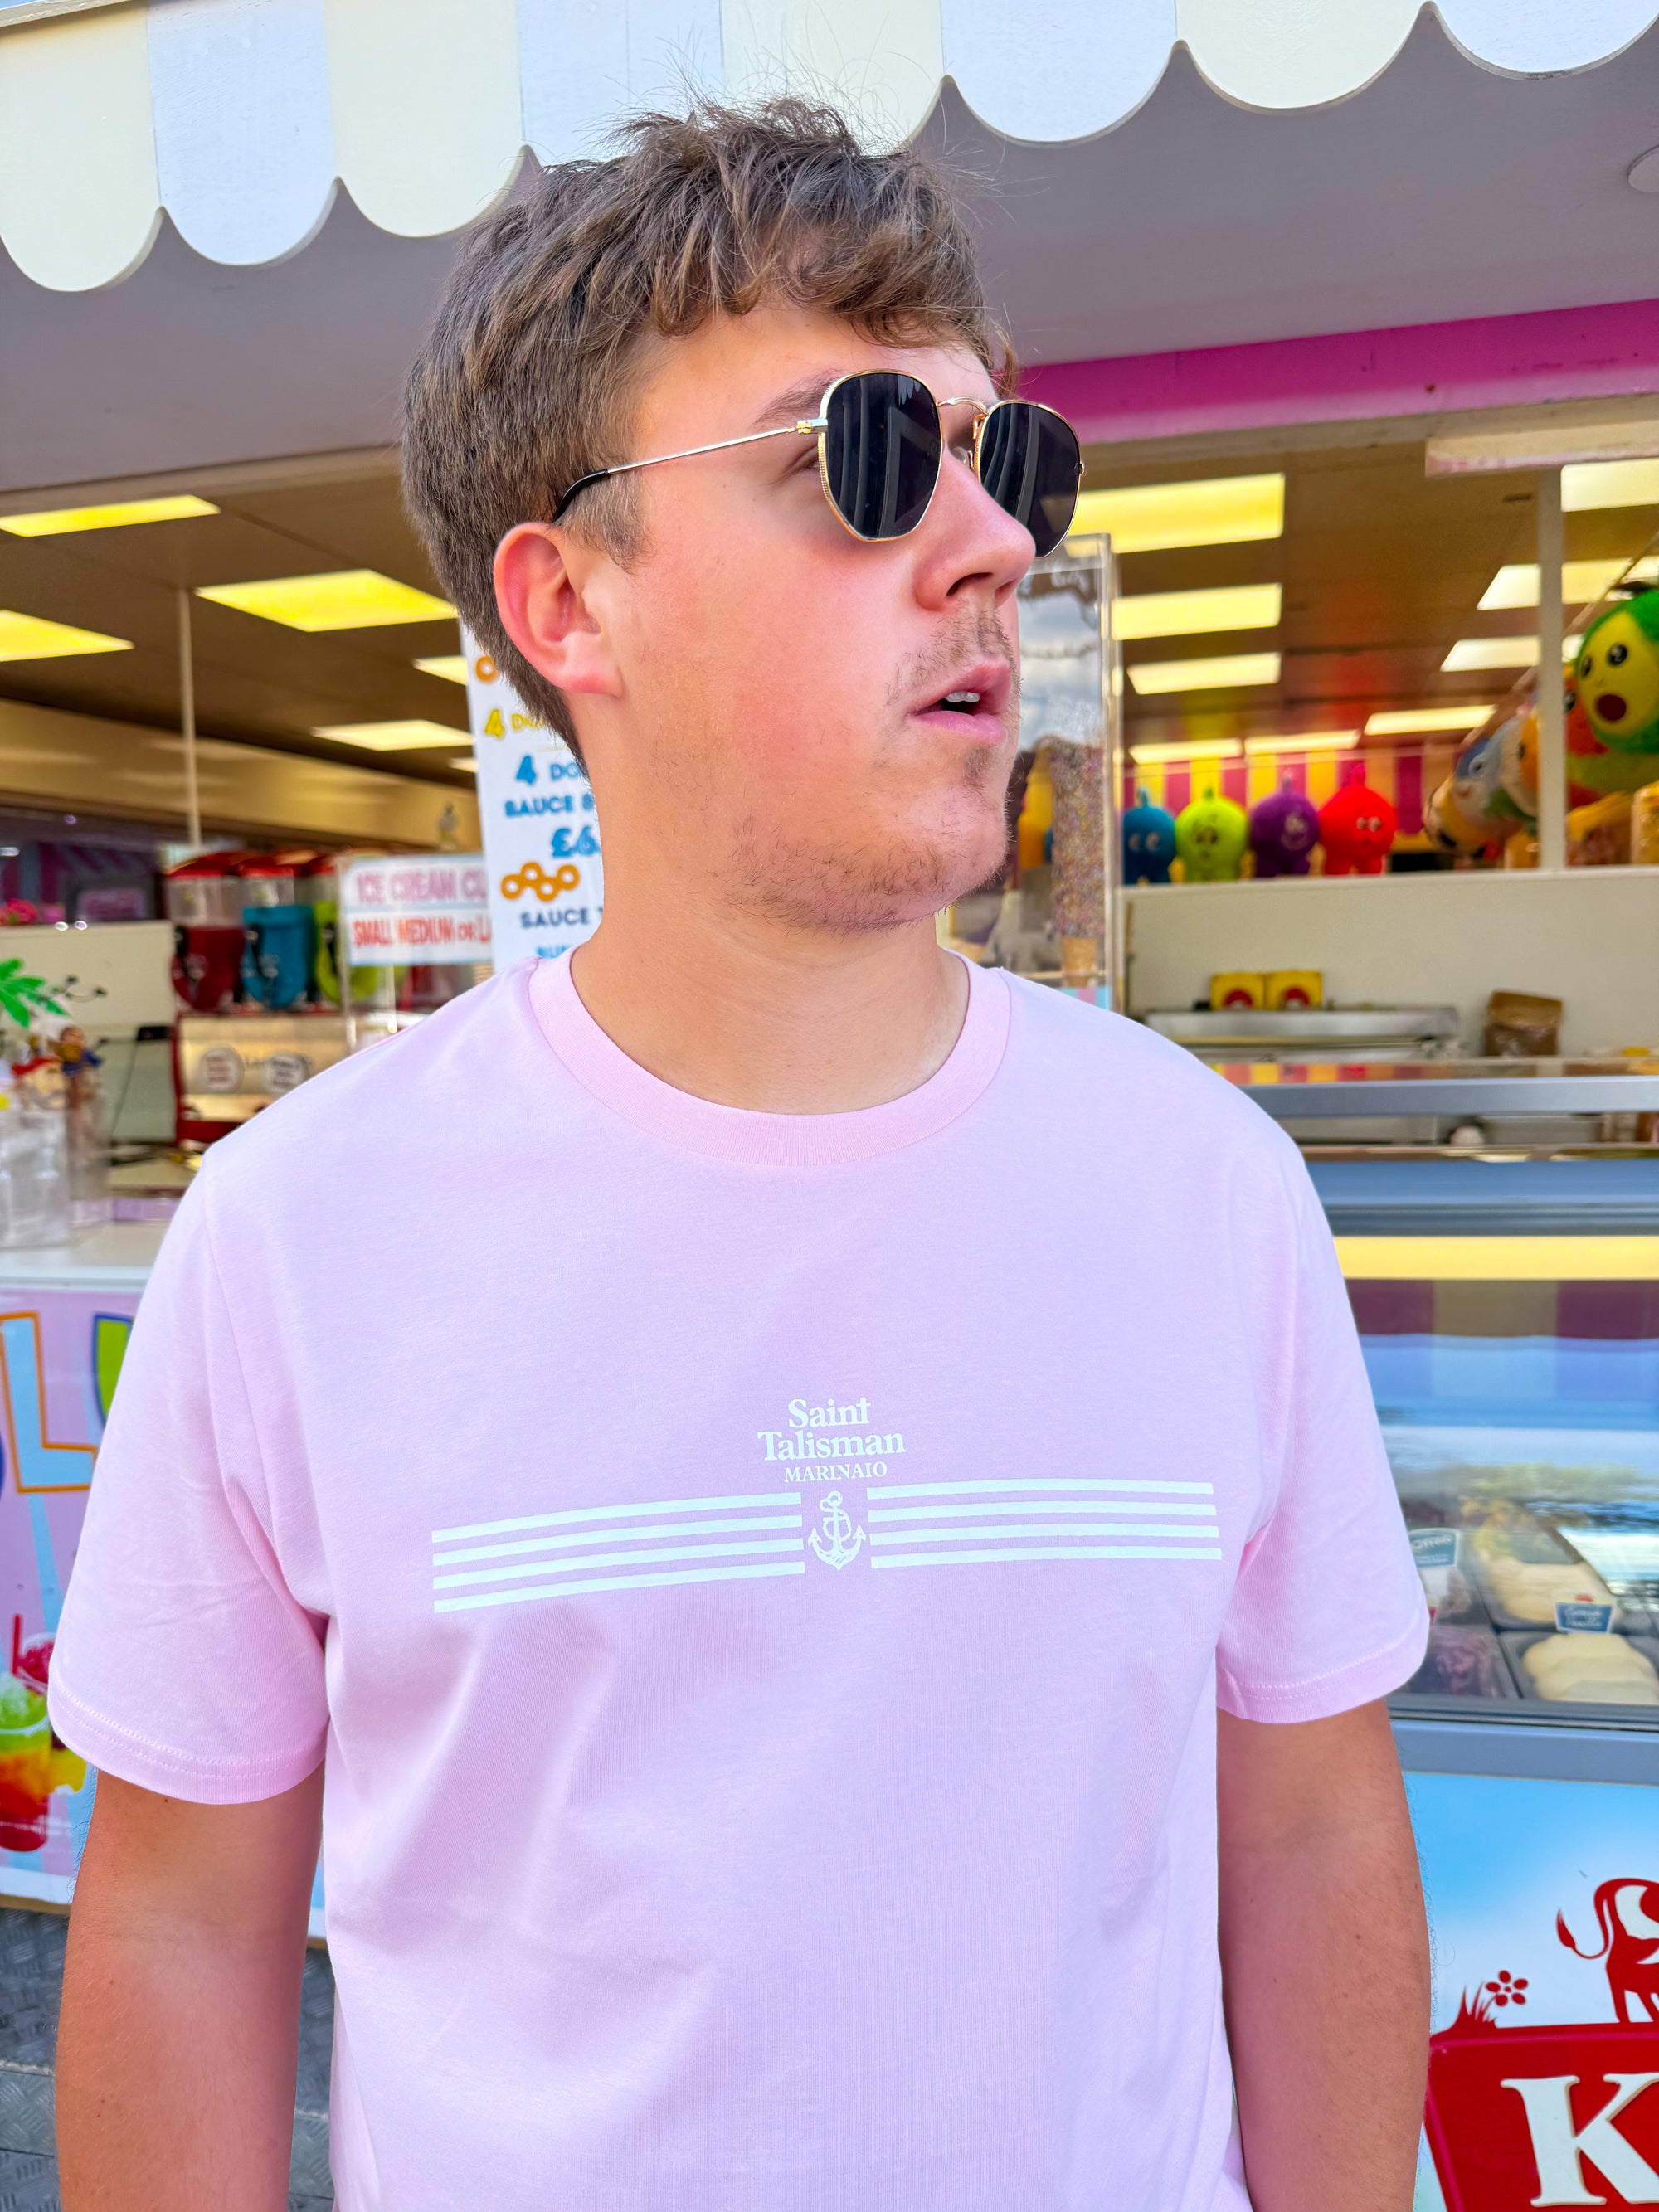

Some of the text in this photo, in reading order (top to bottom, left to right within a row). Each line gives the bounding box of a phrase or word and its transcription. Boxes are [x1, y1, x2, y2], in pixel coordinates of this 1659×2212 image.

[484, 709, 504, 738] 4
[516, 756, 584, 785] 4 DO
[504, 794, 573, 818] SAUCE
[357, 873, 386, 903] ICE
[390, 868, 456, 902] CREAM
[353, 918, 393, 948] SMALL
[397, 916, 455, 946] MEDIUM
[521, 907, 590, 929] SAUCE
[788, 1397, 871, 1428] Saint
[757, 1430, 907, 1461] Talisman
[784, 1461, 888, 1483] MARINAIO
